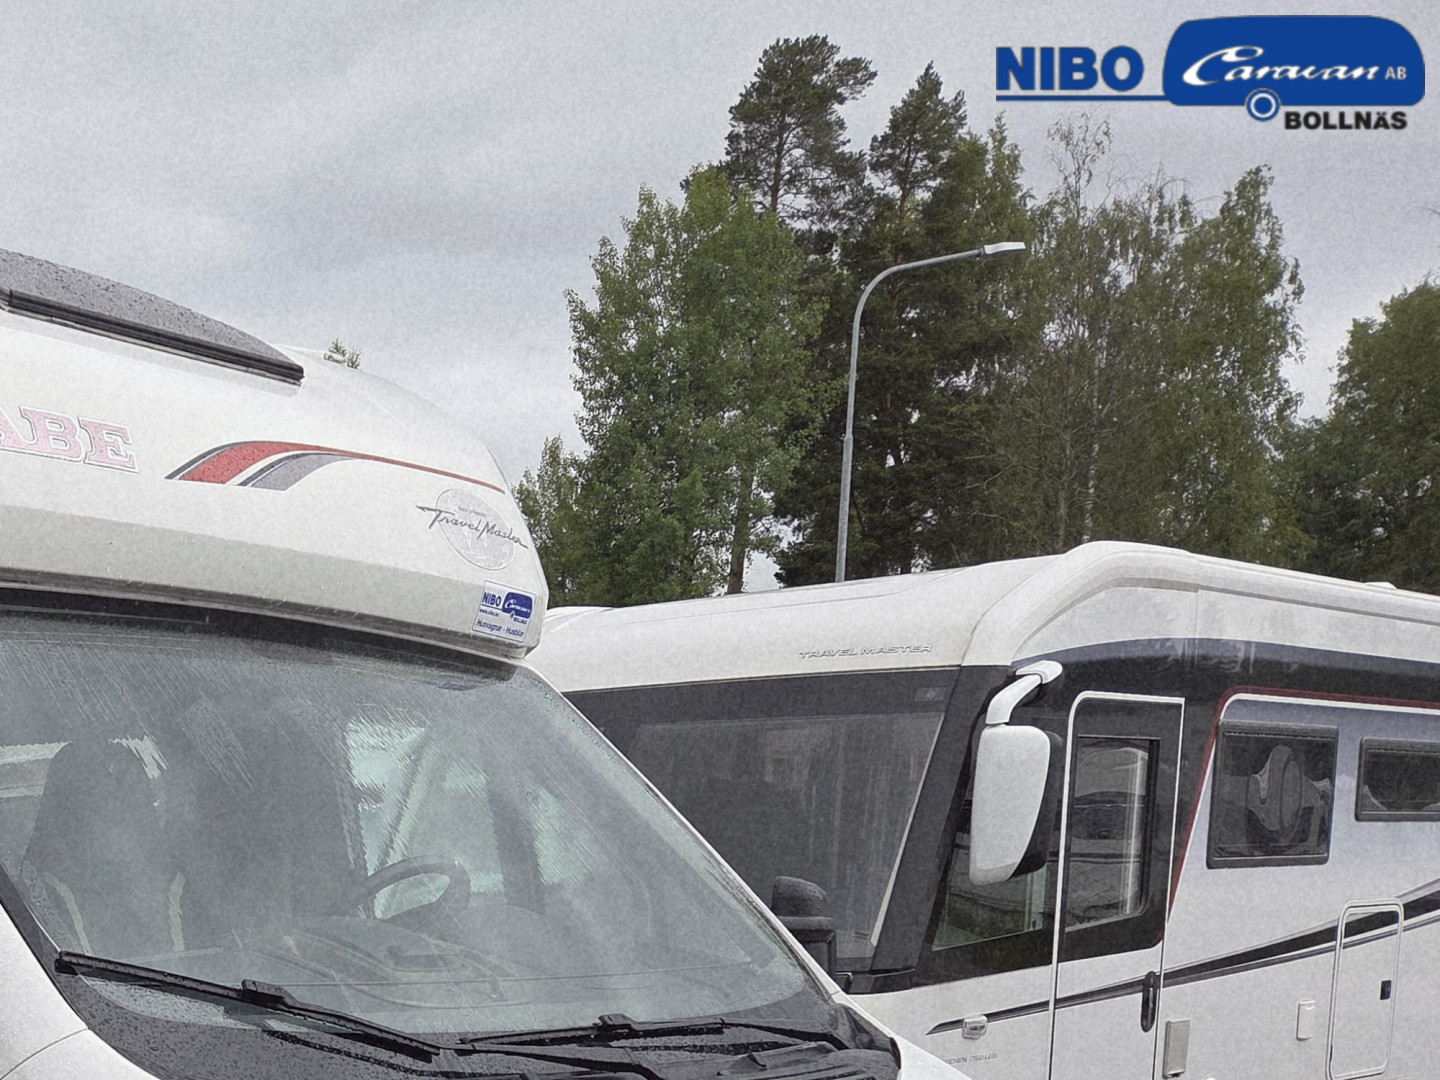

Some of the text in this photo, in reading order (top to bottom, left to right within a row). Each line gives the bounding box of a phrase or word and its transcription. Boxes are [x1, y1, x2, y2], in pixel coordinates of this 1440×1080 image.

[482, 592, 502, 607] NIBO
[799, 643, 933, 660] TRAVEL MASTER
